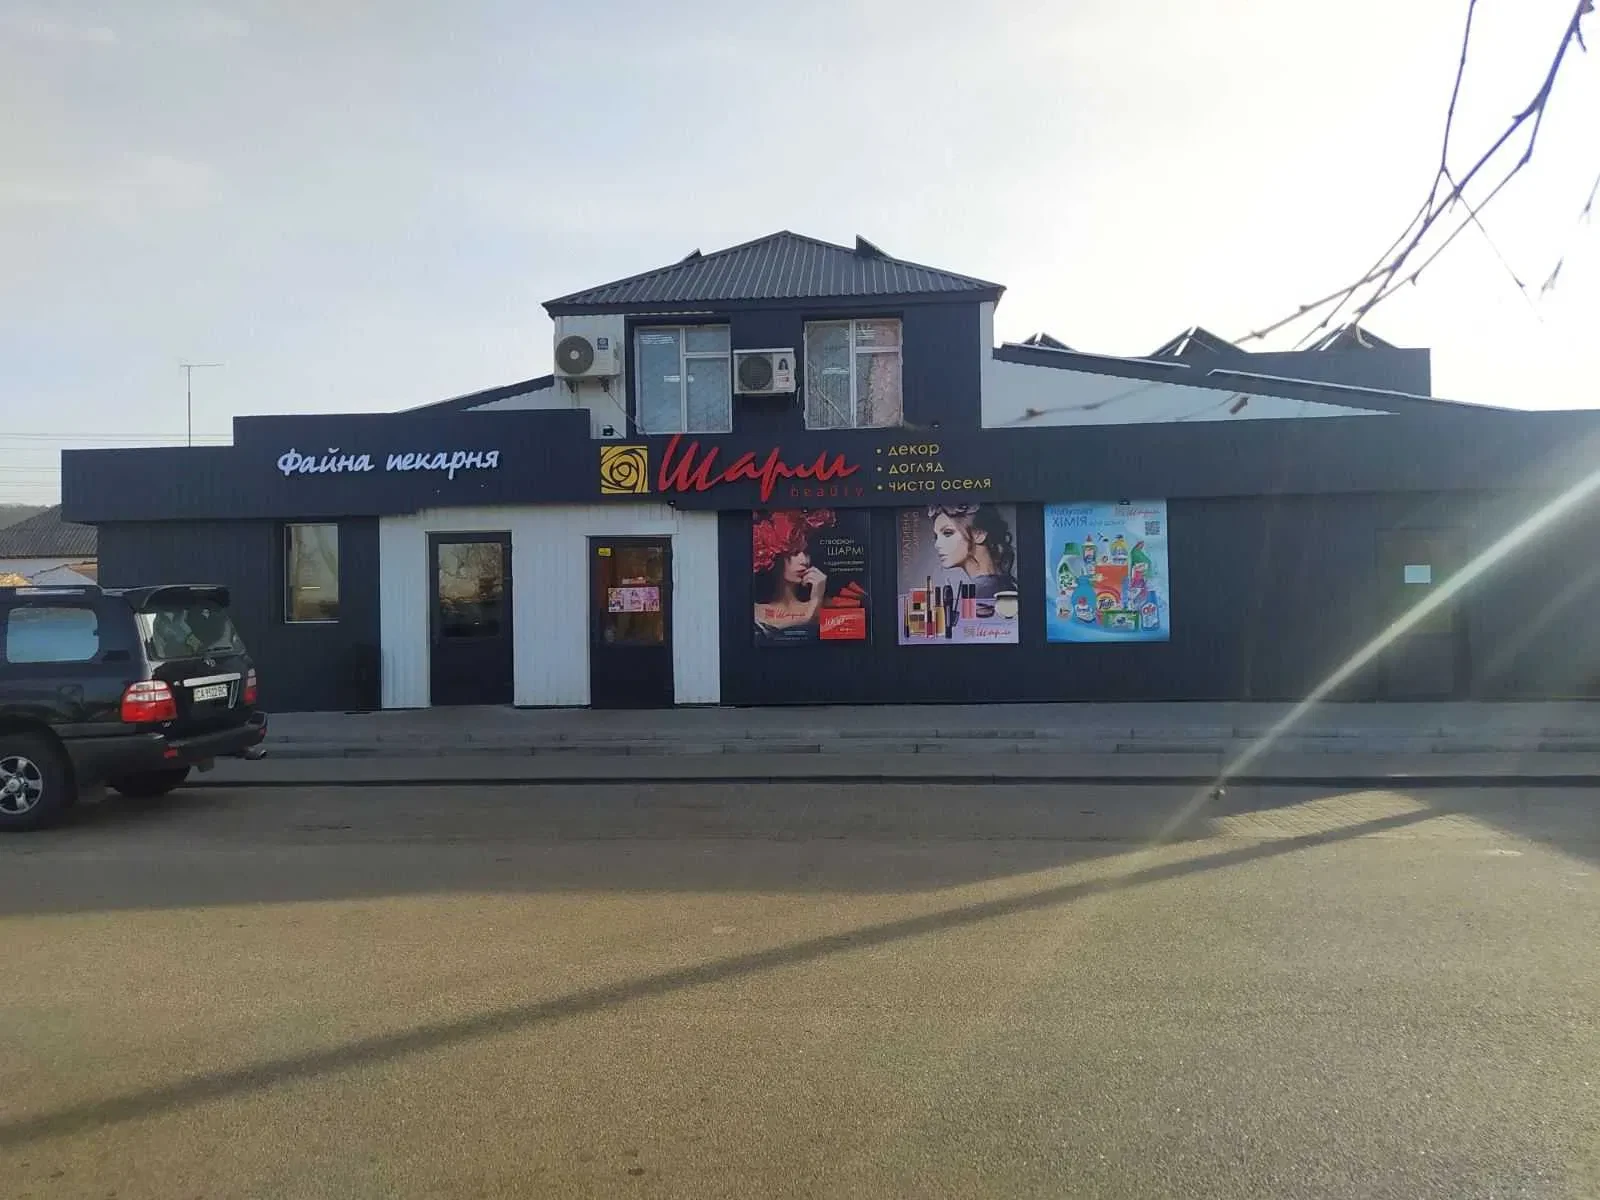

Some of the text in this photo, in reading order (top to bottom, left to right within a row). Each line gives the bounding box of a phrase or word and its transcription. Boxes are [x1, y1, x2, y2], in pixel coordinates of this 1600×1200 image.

[887, 441, 940, 458] декор
[277, 447, 500, 480] Файна пекарня
[657, 432, 862, 502] Шарм
[887, 462, 945, 475] догляд
[887, 476, 992, 493] чиста оселя
